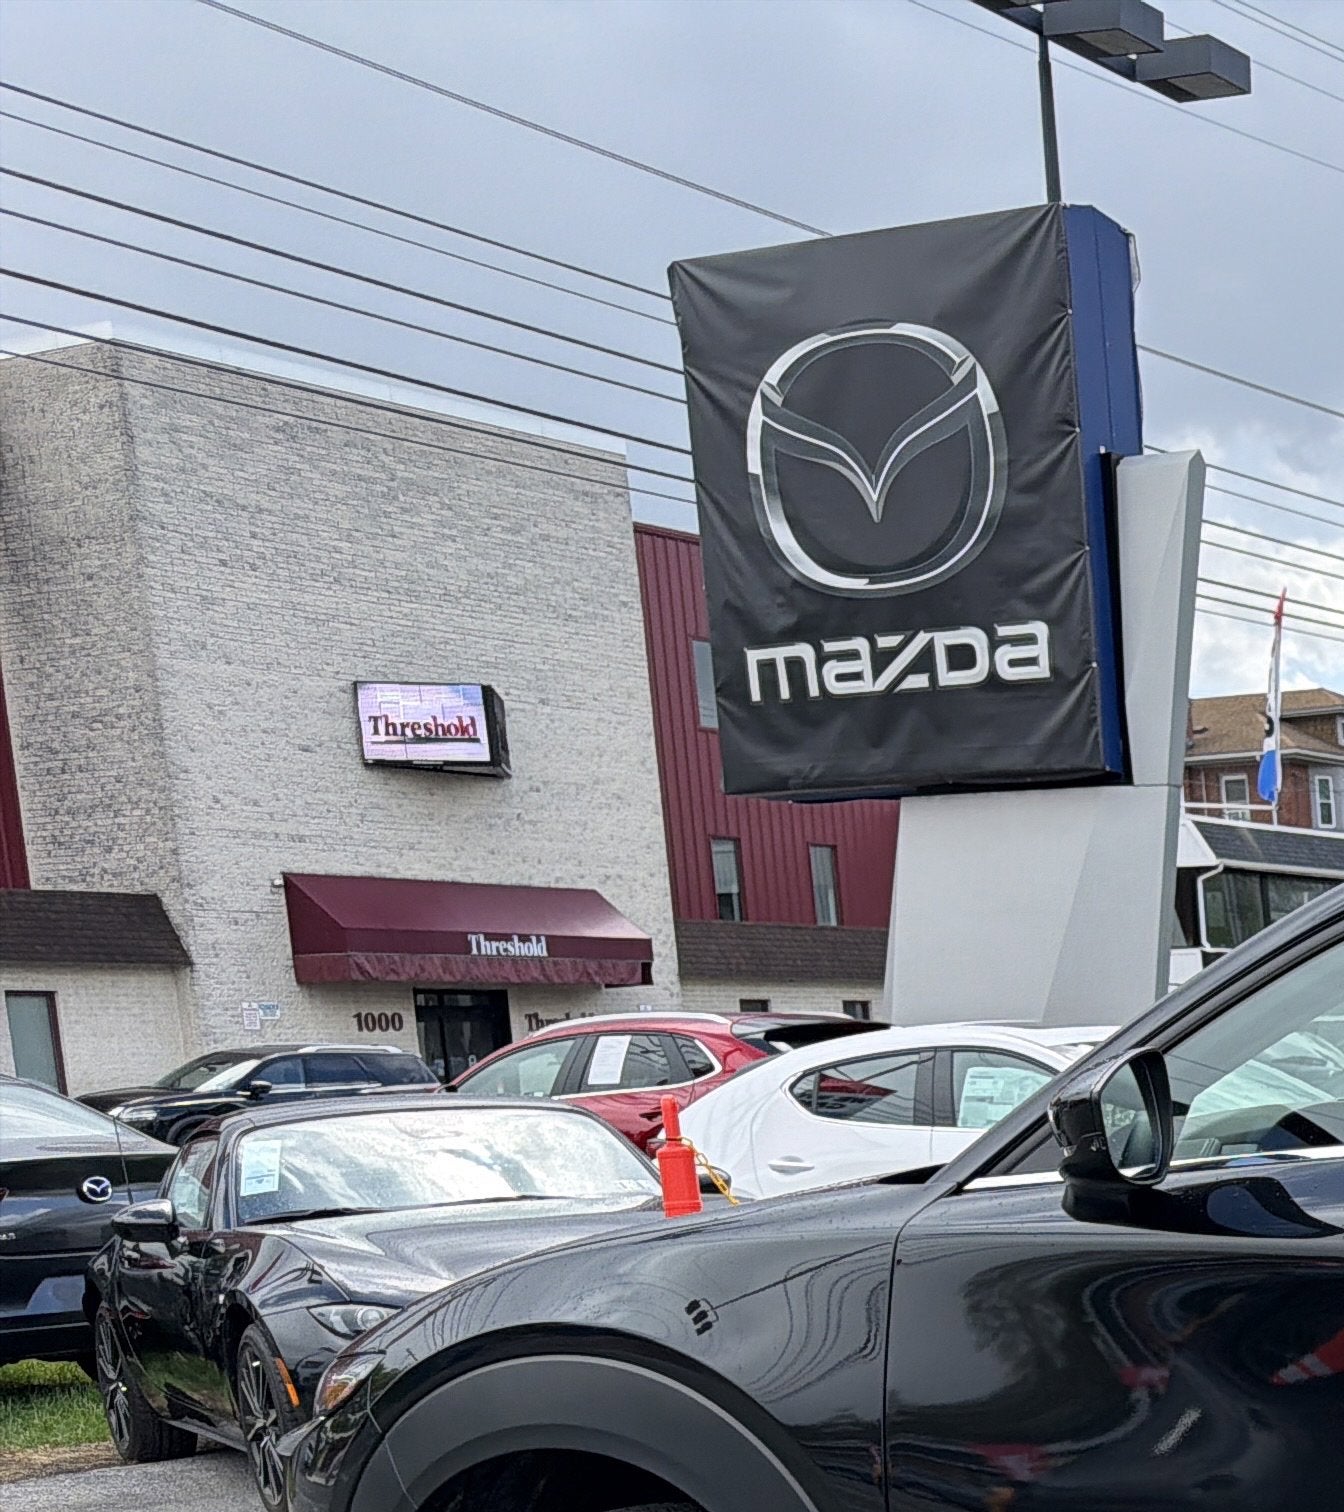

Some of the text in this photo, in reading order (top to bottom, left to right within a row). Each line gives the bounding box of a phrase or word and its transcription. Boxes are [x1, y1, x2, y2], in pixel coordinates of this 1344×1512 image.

[743, 620, 1051, 703] mazda
[368, 713, 478, 737] Threshold
[467, 933, 549, 957] Threshold
[352, 1011, 404, 1032] 1000
